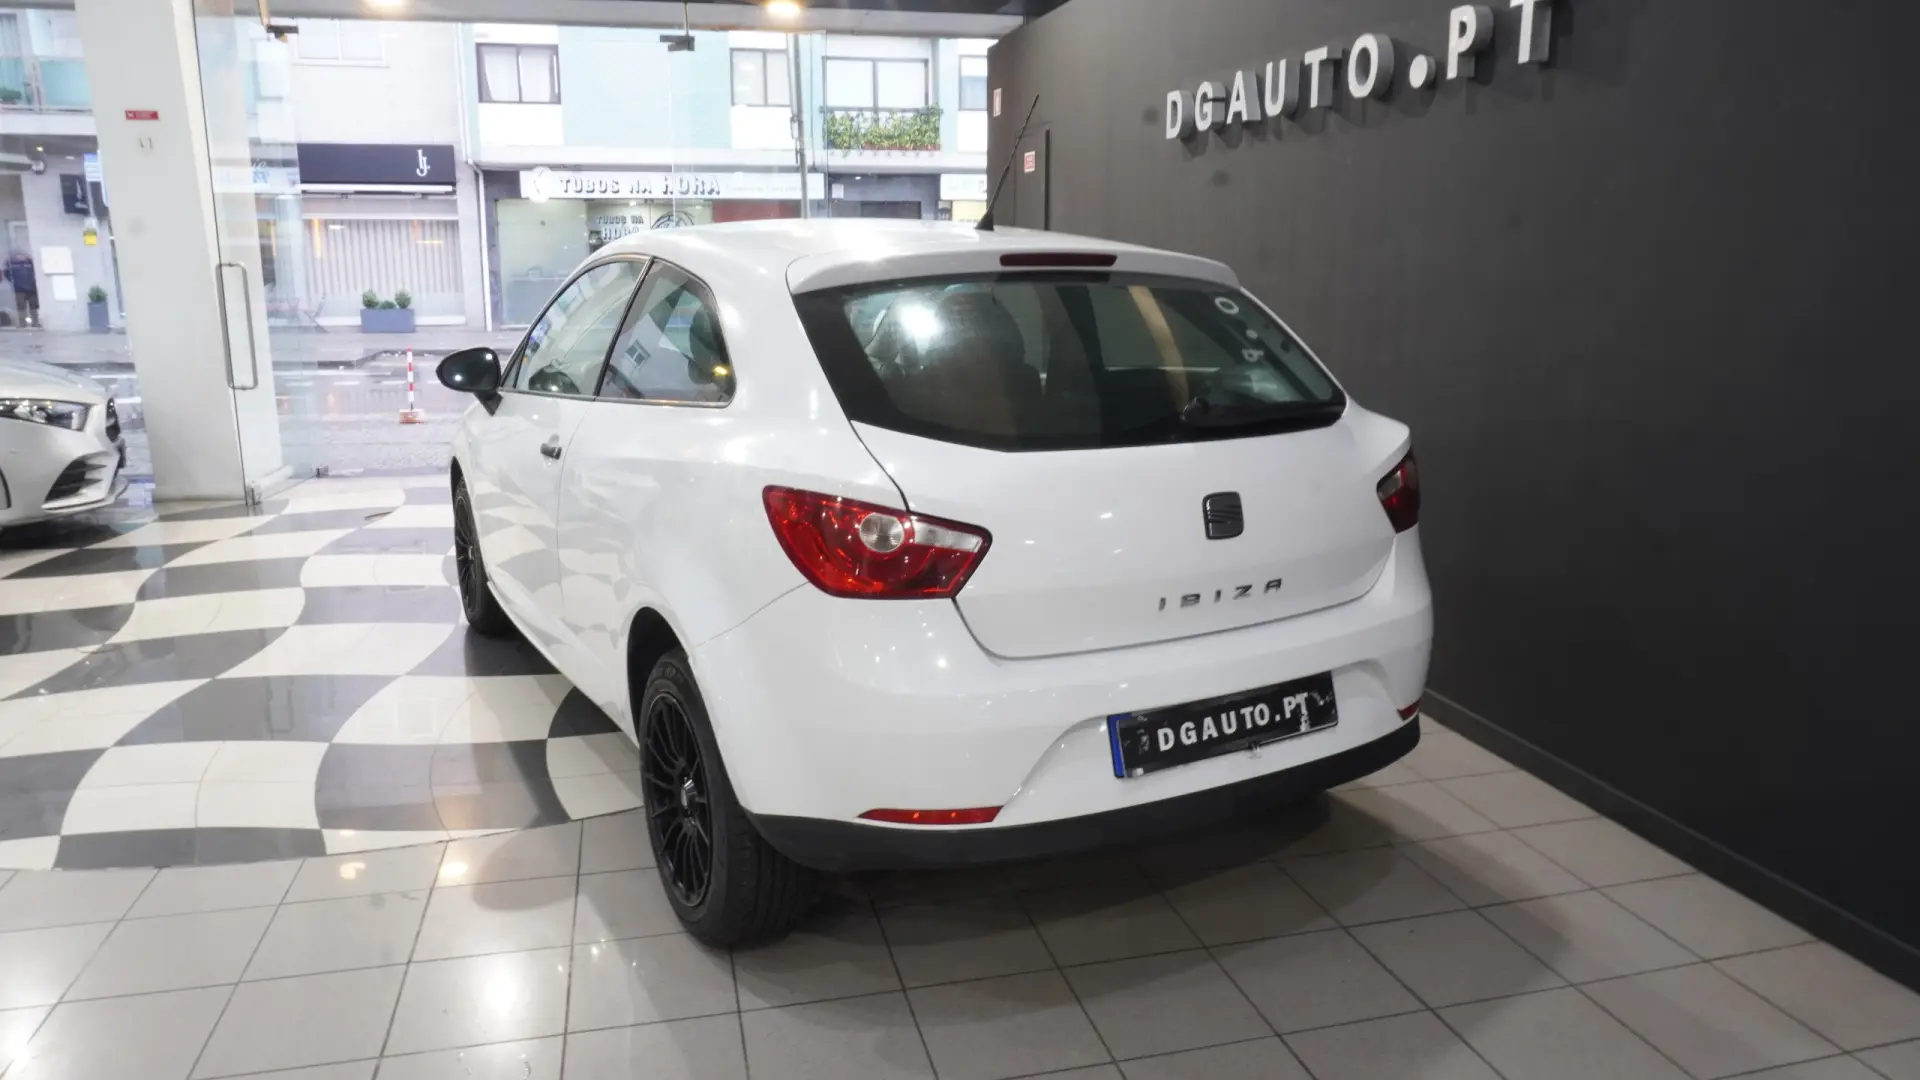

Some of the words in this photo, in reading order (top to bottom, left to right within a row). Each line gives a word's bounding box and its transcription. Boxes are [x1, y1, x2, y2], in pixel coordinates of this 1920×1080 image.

[1166, 0, 1540, 139] DGAUTO.PT
[560, 177, 620, 194] TUBOS
[628, 178, 653, 195] NA
[662, 174, 721, 196] HORA
[596, 214, 627, 225] TUBOS
[630, 214, 644, 225] NA
[1157, 577, 1283, 612] IBIZA
[1156, 691, 1309, 752] DGAUTO.PT
